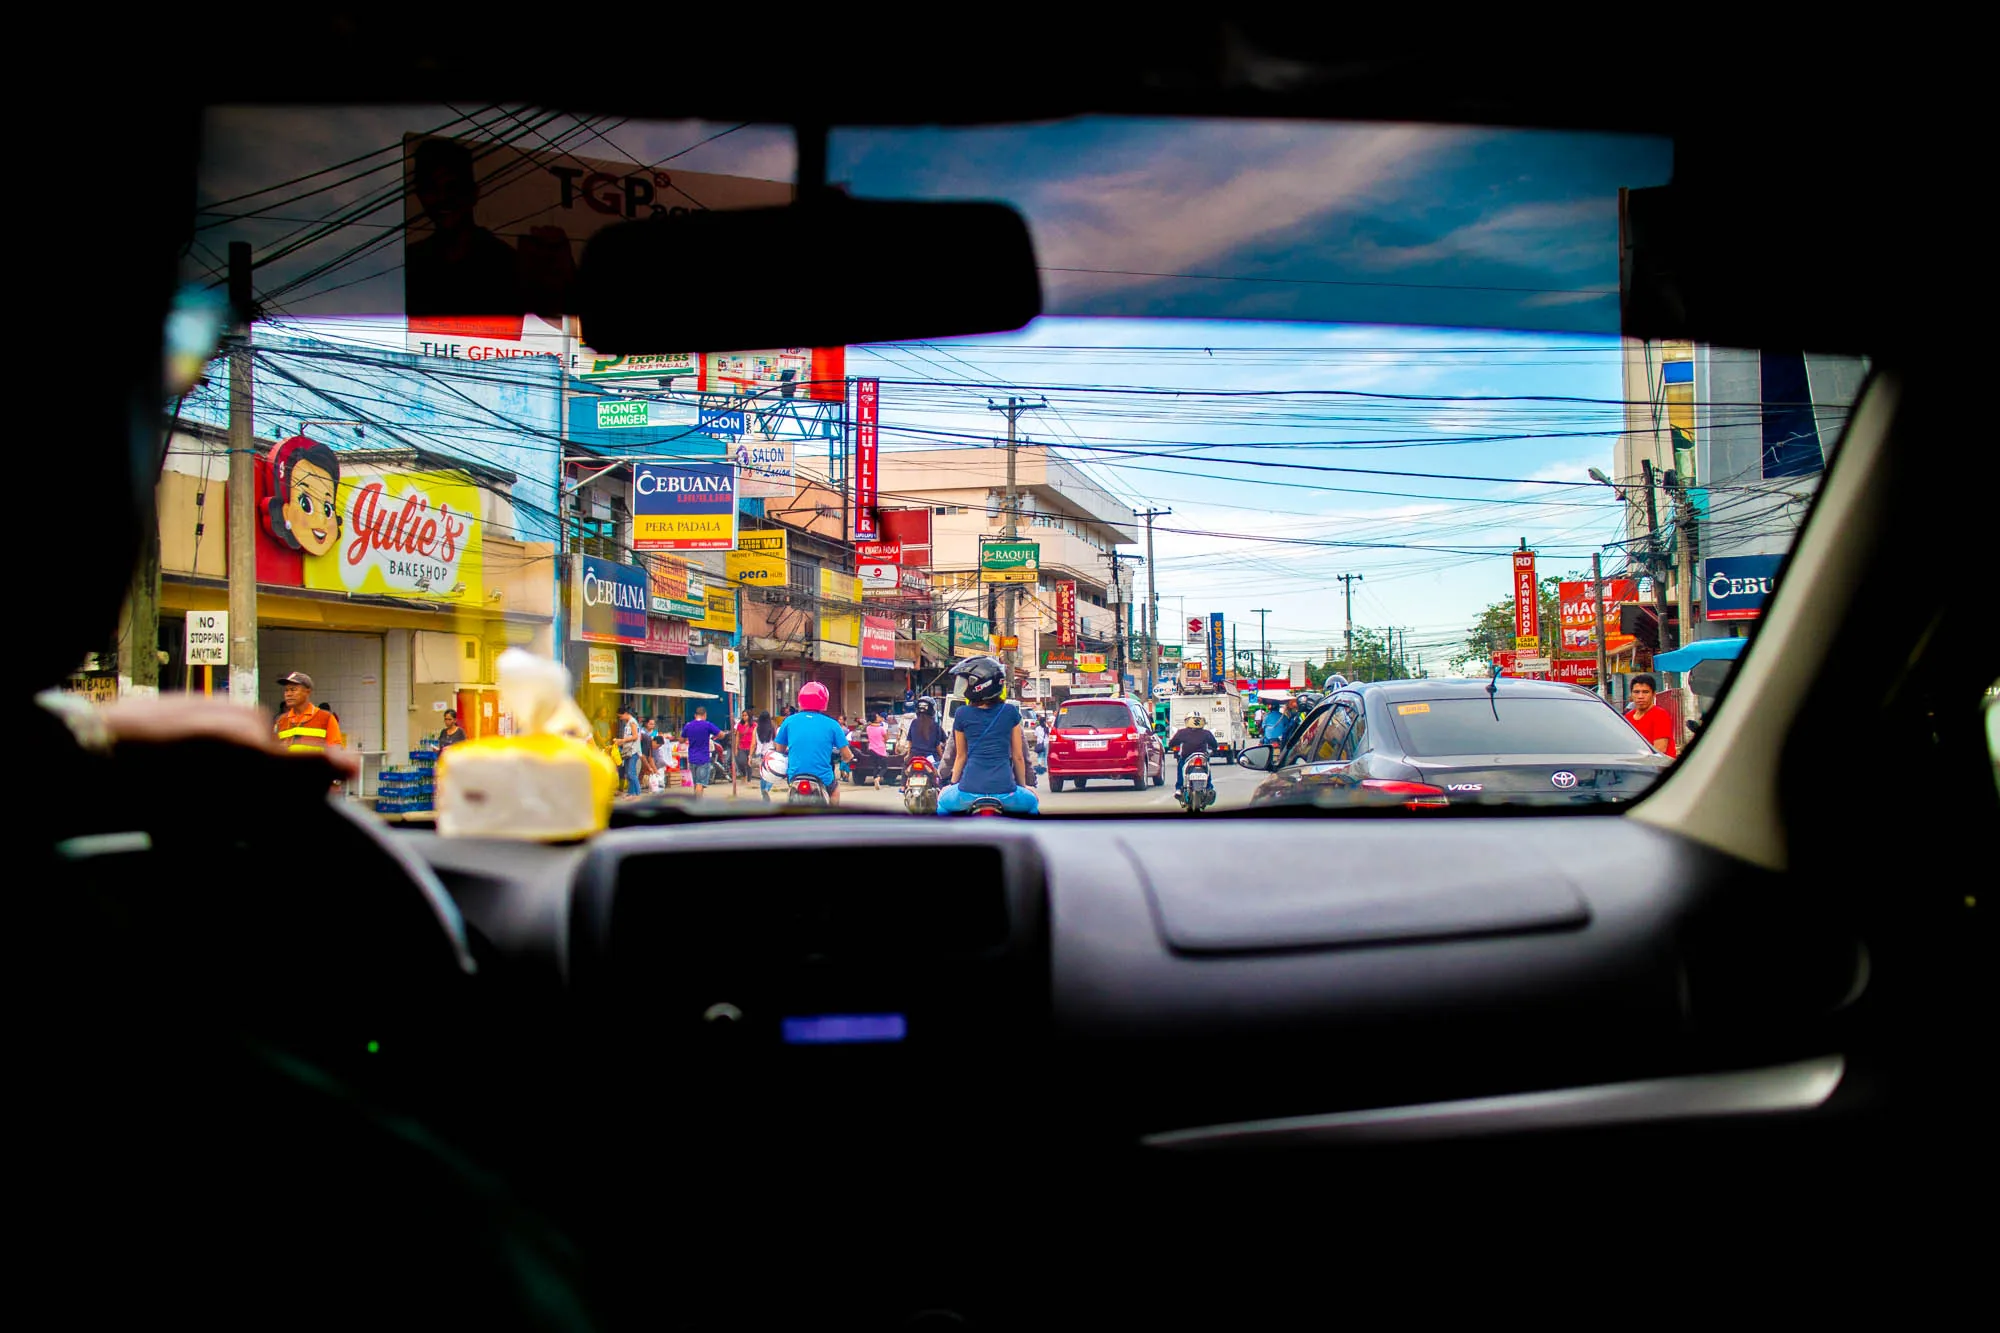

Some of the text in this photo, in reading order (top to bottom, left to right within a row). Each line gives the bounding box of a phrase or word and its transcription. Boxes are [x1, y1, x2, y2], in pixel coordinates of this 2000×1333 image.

[549, 166, 655, 217] TGP
[419, 341, 461, 357] THE
[628, 353, 689, 363] EXPRESS
[600, 403, 645, 414] MONEY
[600, 415, 647, 425] CHANGER
[701, 416, 740, 430] NEON
[752, 448, 784, 463] SALON
[347, 483, 464, 566] Julie's
[645, 521, 721, 532] PERA PADALA
[995, 550, 1036, 560] RAQUEL
[1515, 557, 1531, 566] RD
[389, 560, 448, 580] BAKESHOP
[739, 570, 768, 580] pera
[1521, 574, 1531, 635] PAWNSHOP
[199, 616, 215, 628] NO
[190, 632, 225, 644] STOPPING
[191, 648, 222, 659] ANYTIME
[1214, 620, 1223, 676] Motortrade
[1447, 783, 1482, 791] VIOS
